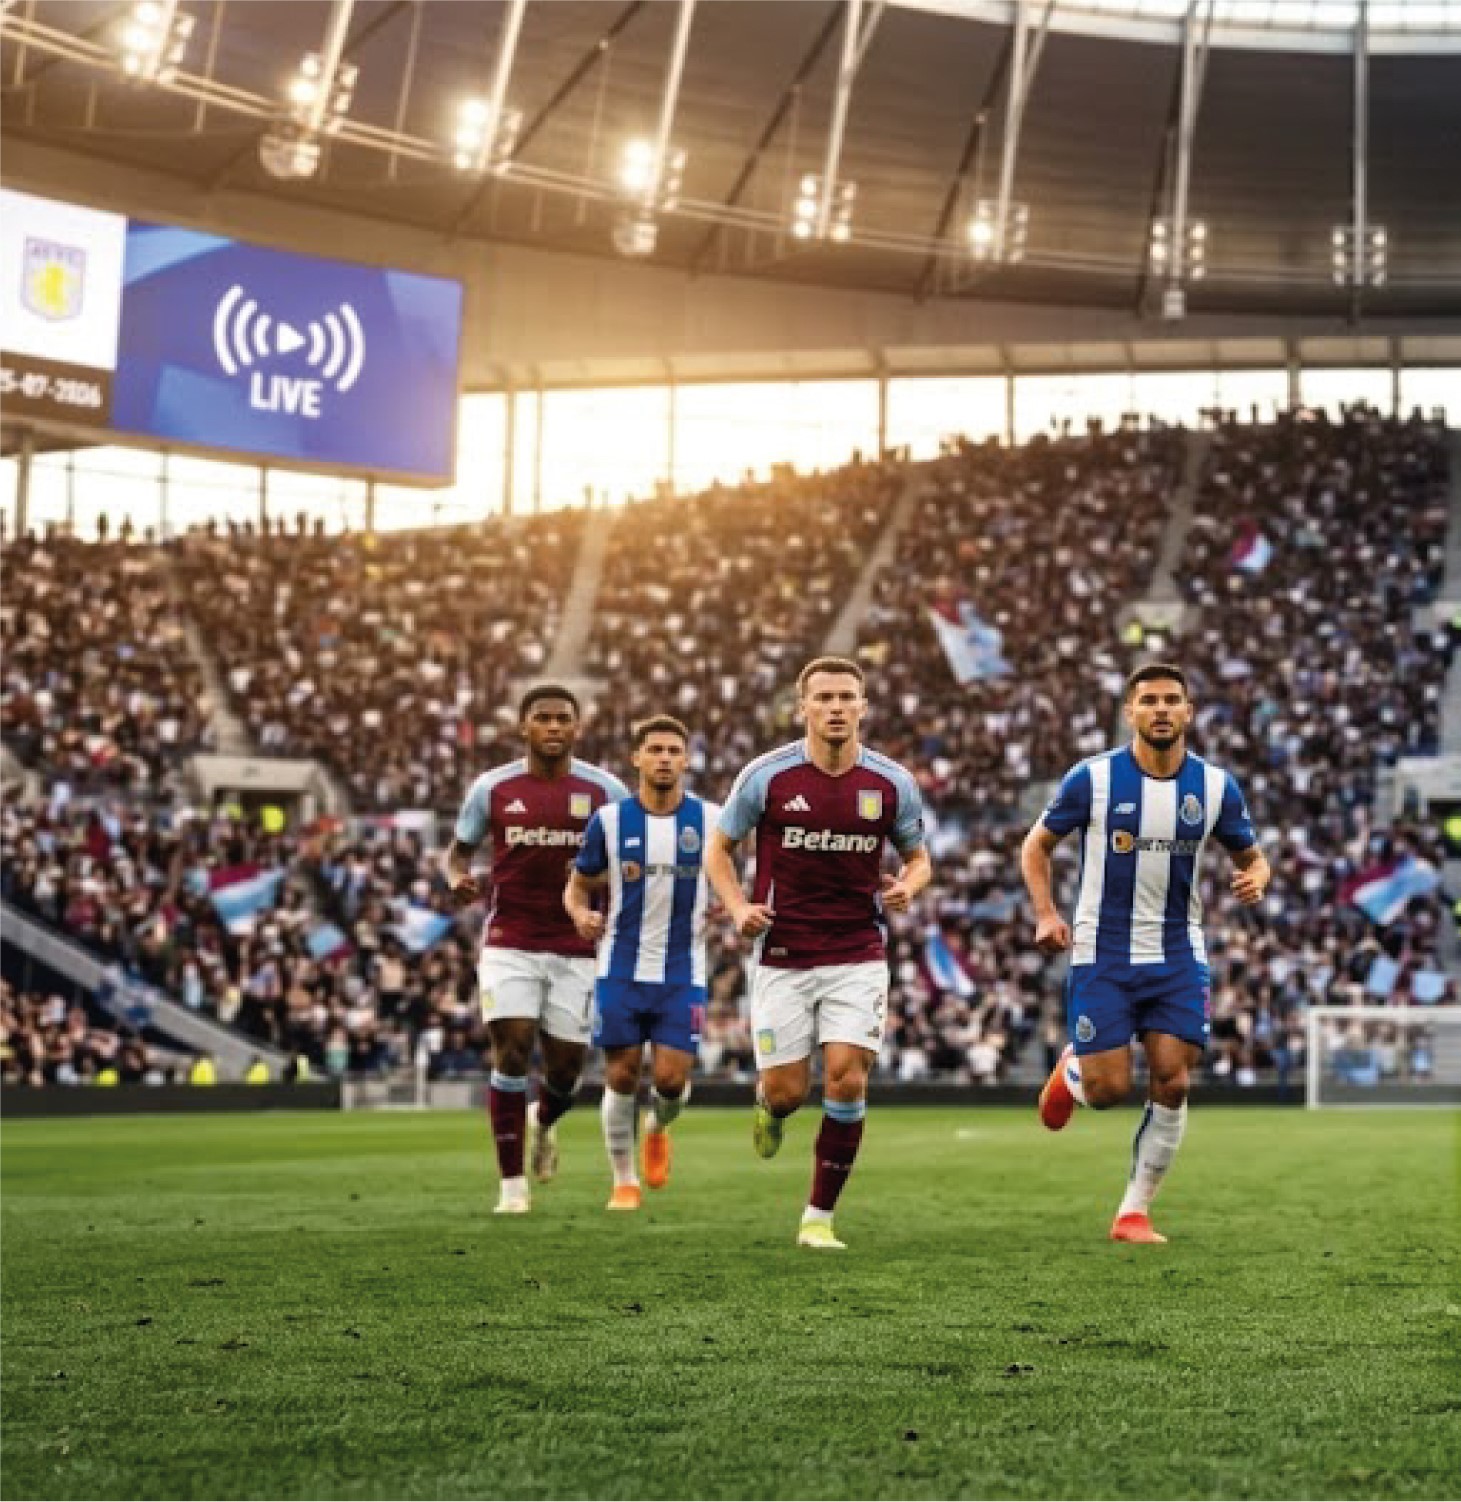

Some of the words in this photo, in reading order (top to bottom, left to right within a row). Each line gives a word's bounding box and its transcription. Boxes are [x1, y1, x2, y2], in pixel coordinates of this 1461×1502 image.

[0, 369, 102, 408] 5-07-2026
[249, 371, 324, 418] LIVE
[782, 826, 879, 853] Betano
